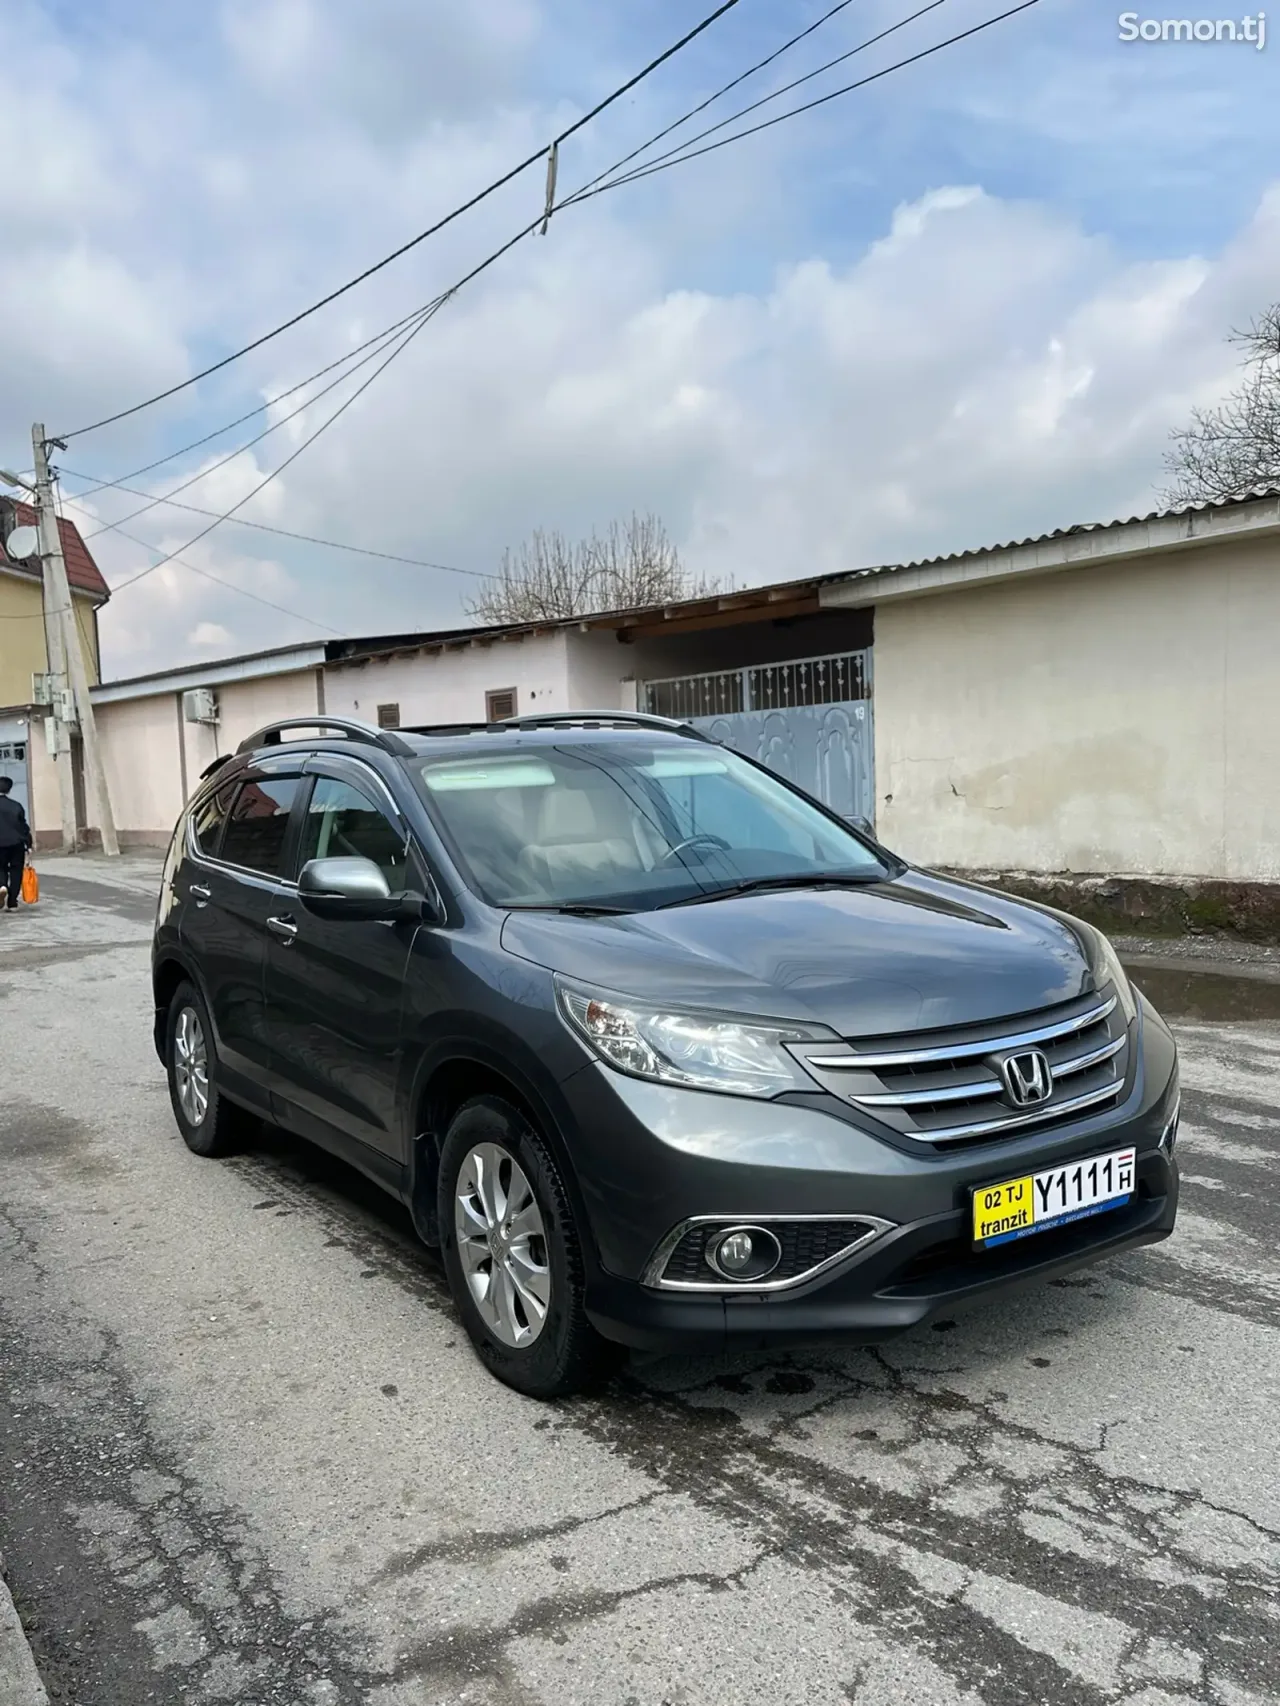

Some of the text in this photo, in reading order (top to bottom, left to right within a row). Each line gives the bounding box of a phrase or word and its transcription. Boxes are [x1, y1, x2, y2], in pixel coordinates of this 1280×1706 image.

[984, 1183, 1023, 1210] 02 TJ
[1035, 1158, 1131, 1213] Y1111 H
[980, 1208, 1028, 1237] tranzit
